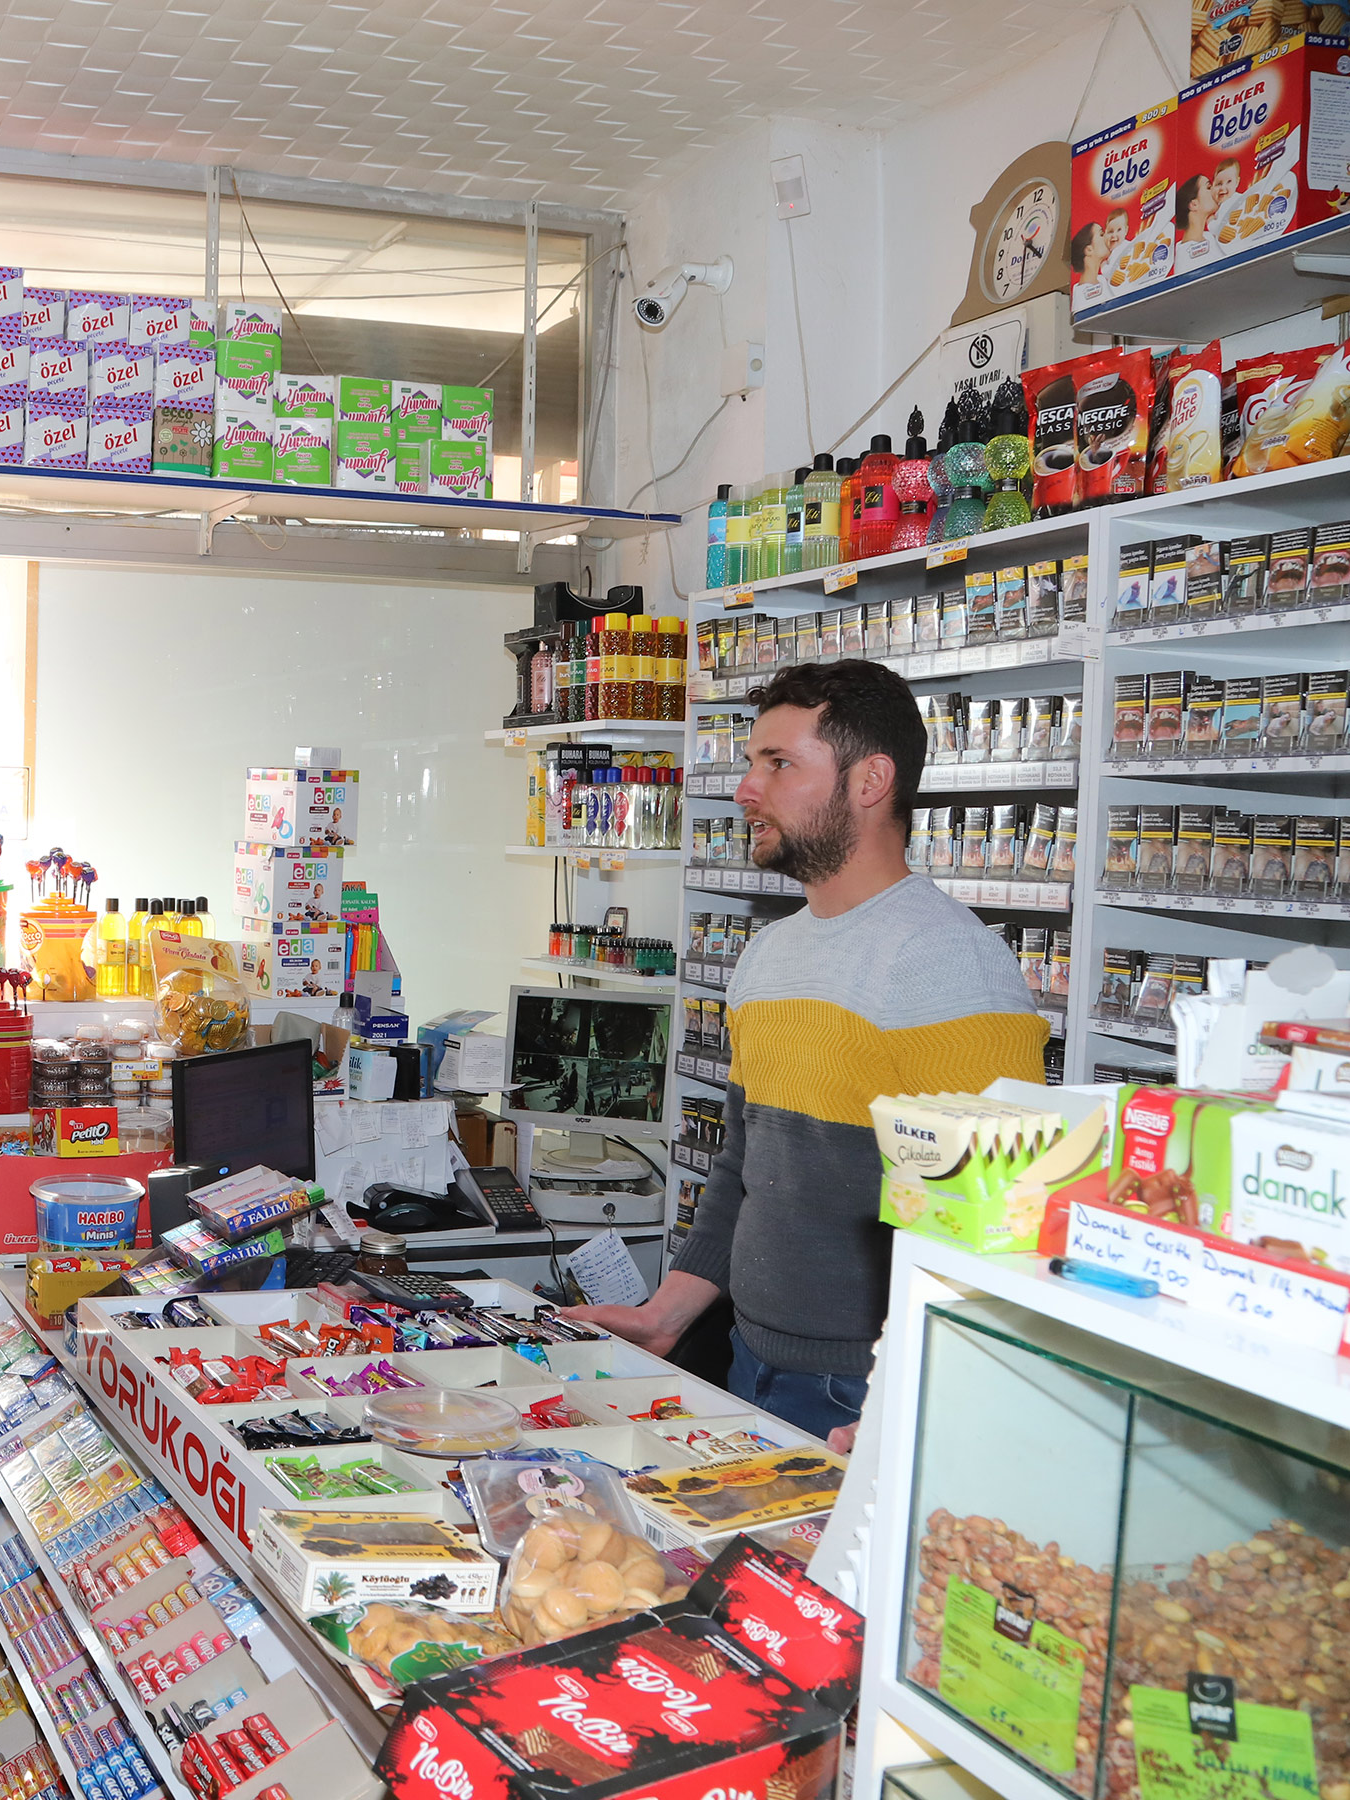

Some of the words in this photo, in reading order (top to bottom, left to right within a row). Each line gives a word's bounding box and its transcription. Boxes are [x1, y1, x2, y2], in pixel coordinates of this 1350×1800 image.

[1258, 48, 1278, 64] 800
[1214, 81, 1265, 115] ÜLKER
[1141, 109, 1158, 123] 800
[1209, 102, 1268, 146] Bebe
[1104, 138, 1148, 168] ÜLKER
[1100, 158, 1150, 196] Bebe
[1033, 188, 1044, 204] 12
[1016, 206, 1025, 219] 11
[1003, 228, 1014, 242] 10
[998, 249, 1005, 262] 9
[996, 267, 1004, 281] 8
[1002, 284, 1010, 298] 7
[146, 315, 179, 338] özel
[173, 367, 204, 389] özel
[1078, 419, 1124, 436] CLASSIC
[104, 427, 138, 451] özel
[248, 794, 271, 812] eda
[314, 787, 346, 805] eda
[293, 862, 328, 881] eda
[278, 937, 314, 957] eda
[372, 1022, 401, 1030] PENSAN
[1125, 1107, 1170, 1131] Nestlé
[894, 1118, 938, 1144] ÜLKER
[897, 1145, 942, 1165] Çikolata
[1243, 1152, 1346, 1219] damak
[78, 1210, 125, 1225] HARIBO
[248, 1203, 290, 1225] FALIM
[4, 1233, 38, 1244] ÜLKER
